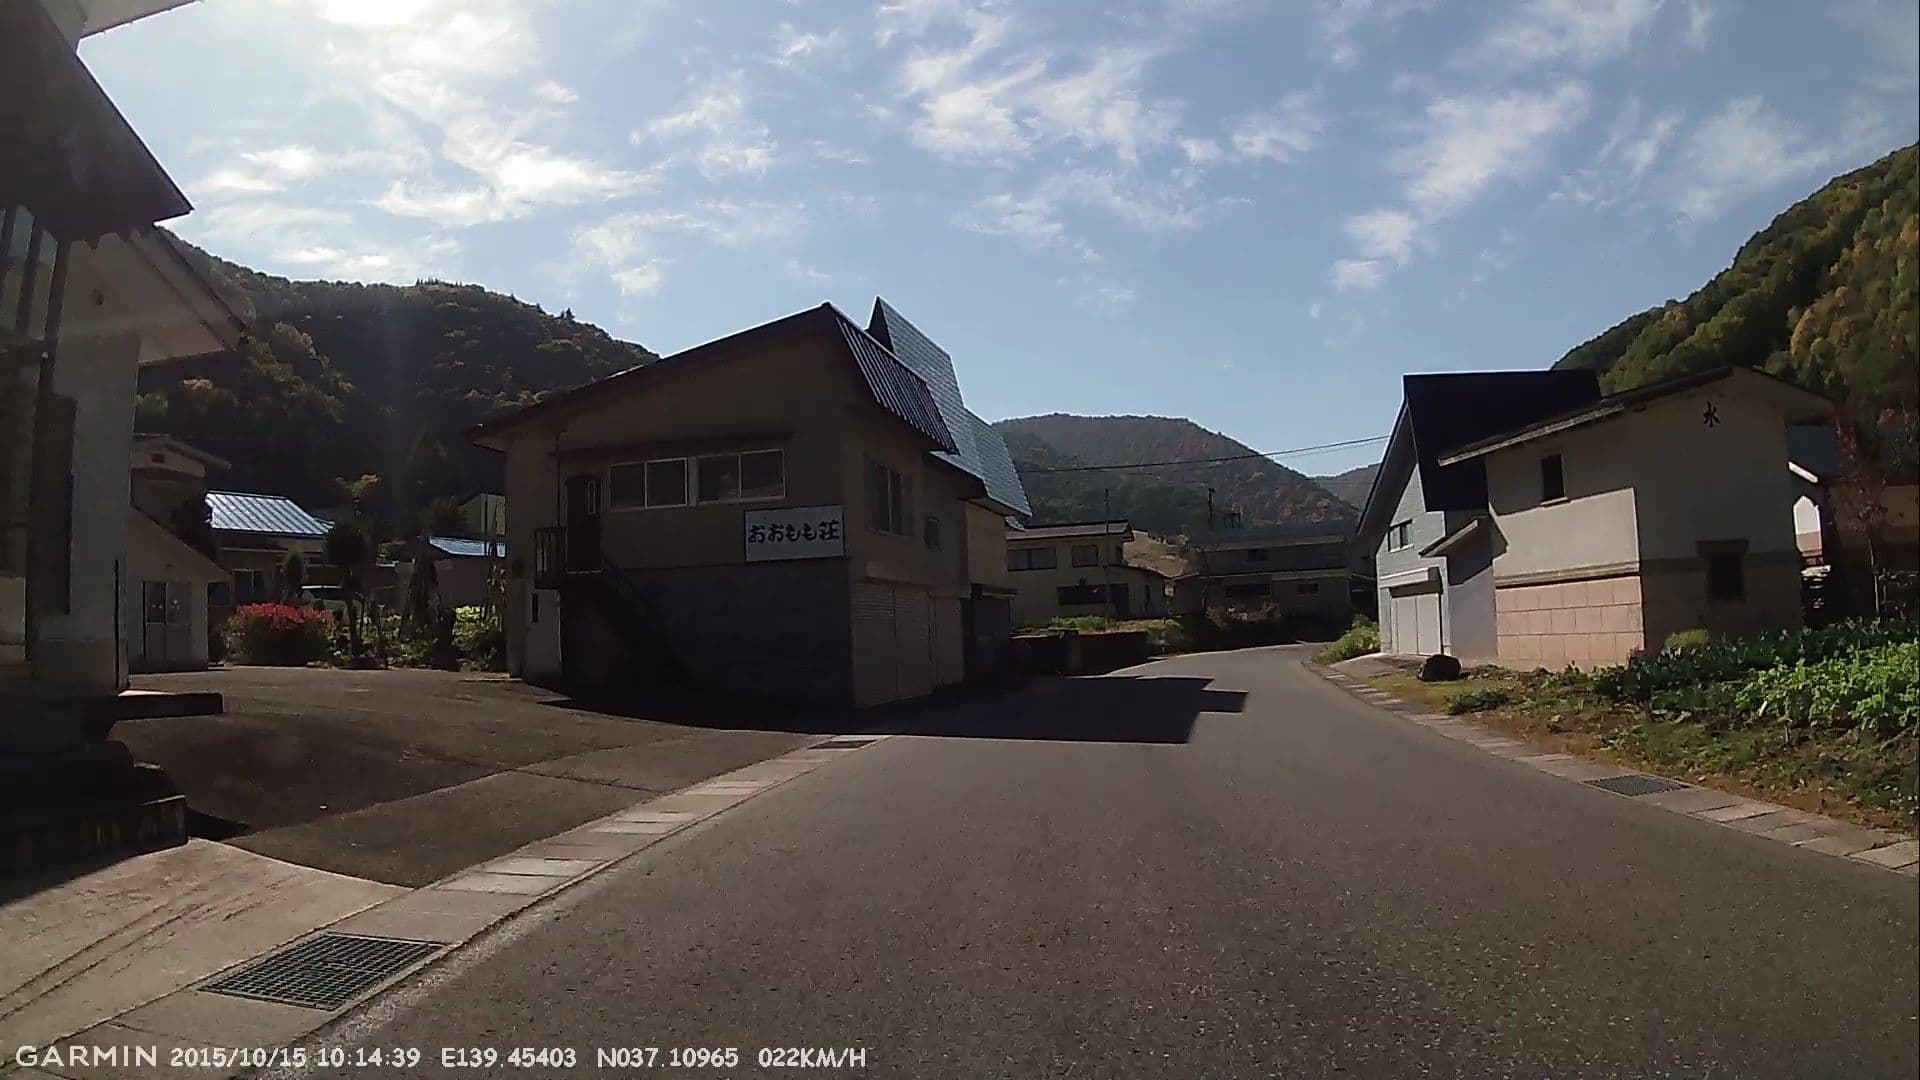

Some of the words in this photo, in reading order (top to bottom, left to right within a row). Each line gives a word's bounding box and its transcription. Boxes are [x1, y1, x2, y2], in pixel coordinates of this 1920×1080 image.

[1702, 400, 1721, 428] 水
[748, 518, 840, 544] おおもも荘
